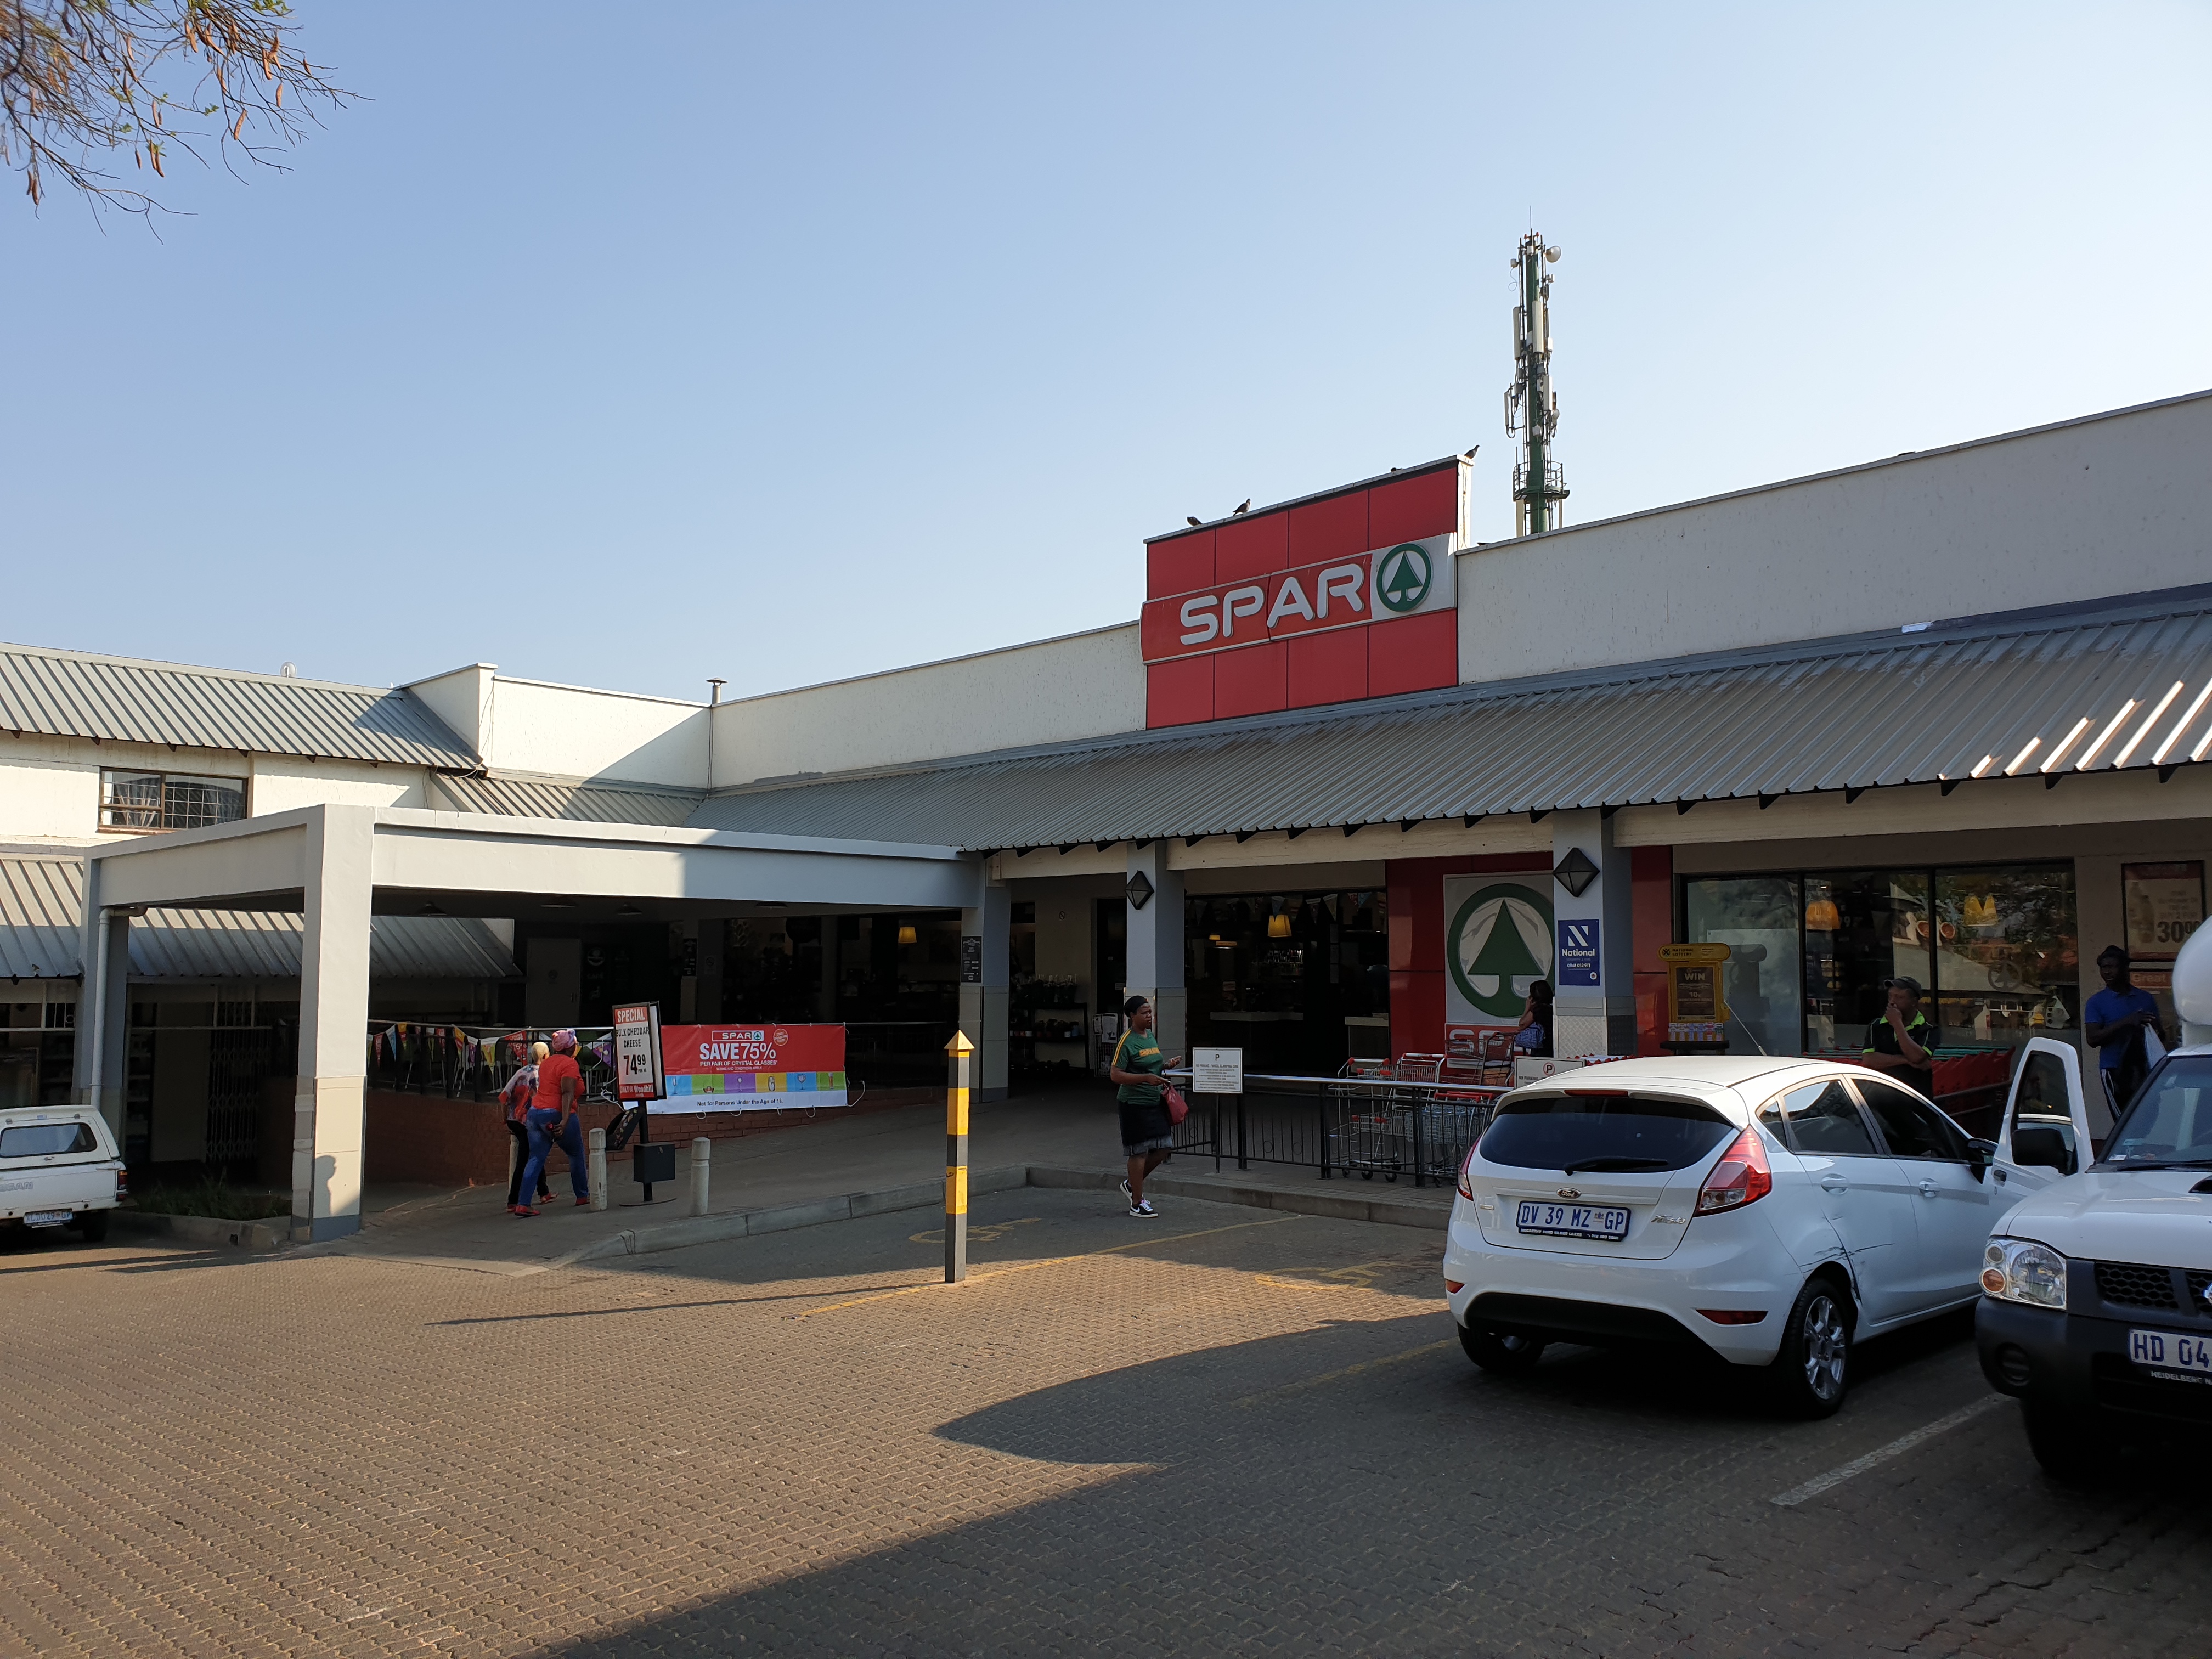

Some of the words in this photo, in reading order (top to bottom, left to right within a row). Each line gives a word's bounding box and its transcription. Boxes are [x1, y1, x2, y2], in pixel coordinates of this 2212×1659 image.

[1180, 563, 1365, 645] SPAR
[1562, 948, 1595, 956] National
[617, 1008, 645, 1023] SPECIAL
[627, 1026, 650, 1036] CHEDDAR
[623, 1039, 641, 1048] CHEESE
[699, 1043, 740, 1059] SAVE
[741, 1042, 776, 1059] 75%
[1547, 1065, 1553, 1073] P
[1520, 1205, 1539, 1223] DV
[1545, 1207, 1564, 1226] 39
[1571, 1209, 1592, 1228] MZ
[1604, 1211, 1624, 1230] GP
[2134, 1333, 2164, 1362] HD
[2178, 1339, 2209, 1368] 04
